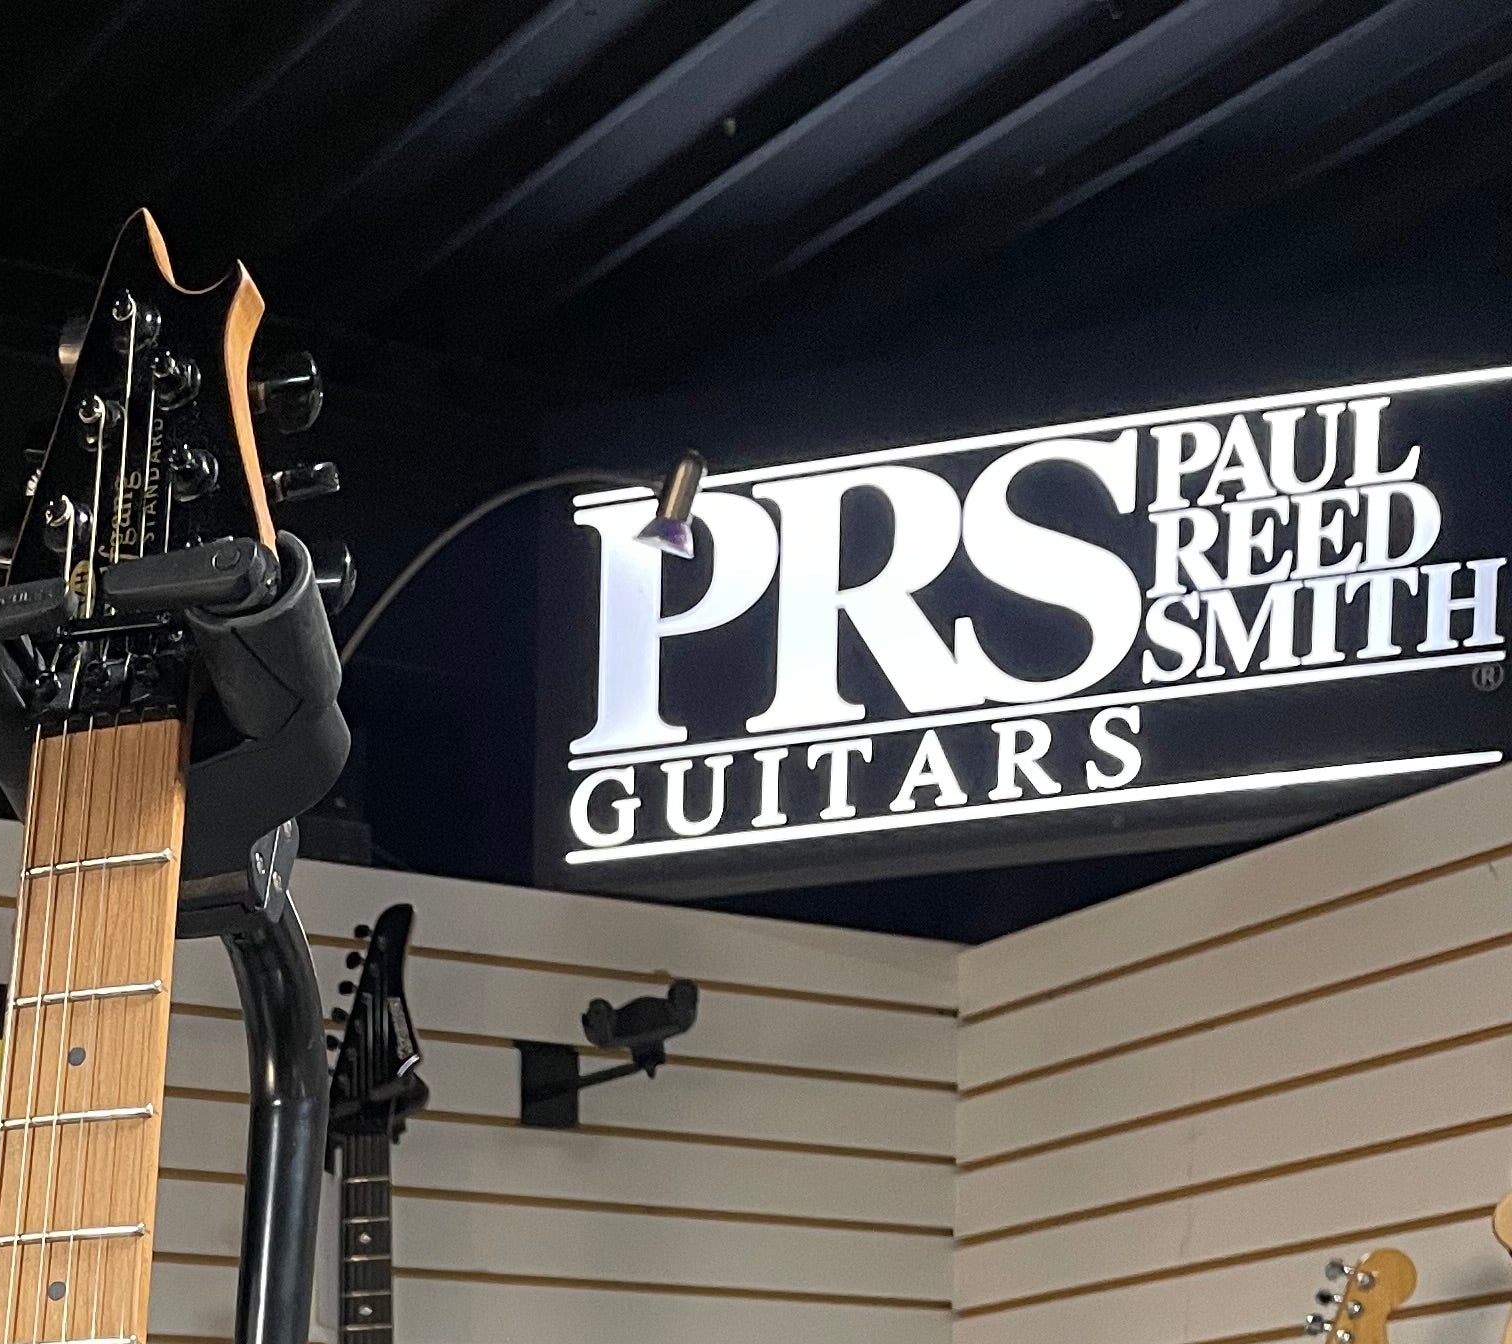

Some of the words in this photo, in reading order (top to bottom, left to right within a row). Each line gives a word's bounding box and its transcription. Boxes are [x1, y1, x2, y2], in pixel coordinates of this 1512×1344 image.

[143, 416, 166, 543] STANDARD
[1150, 396, 1422, 512] PAUL
[569, 428, 1140, 756] PRS
[1149, 480, 1443, 598] REED
[1141, 557, 1507, 684] SMITH
[569, 704, 1144, 849] GUITARS
